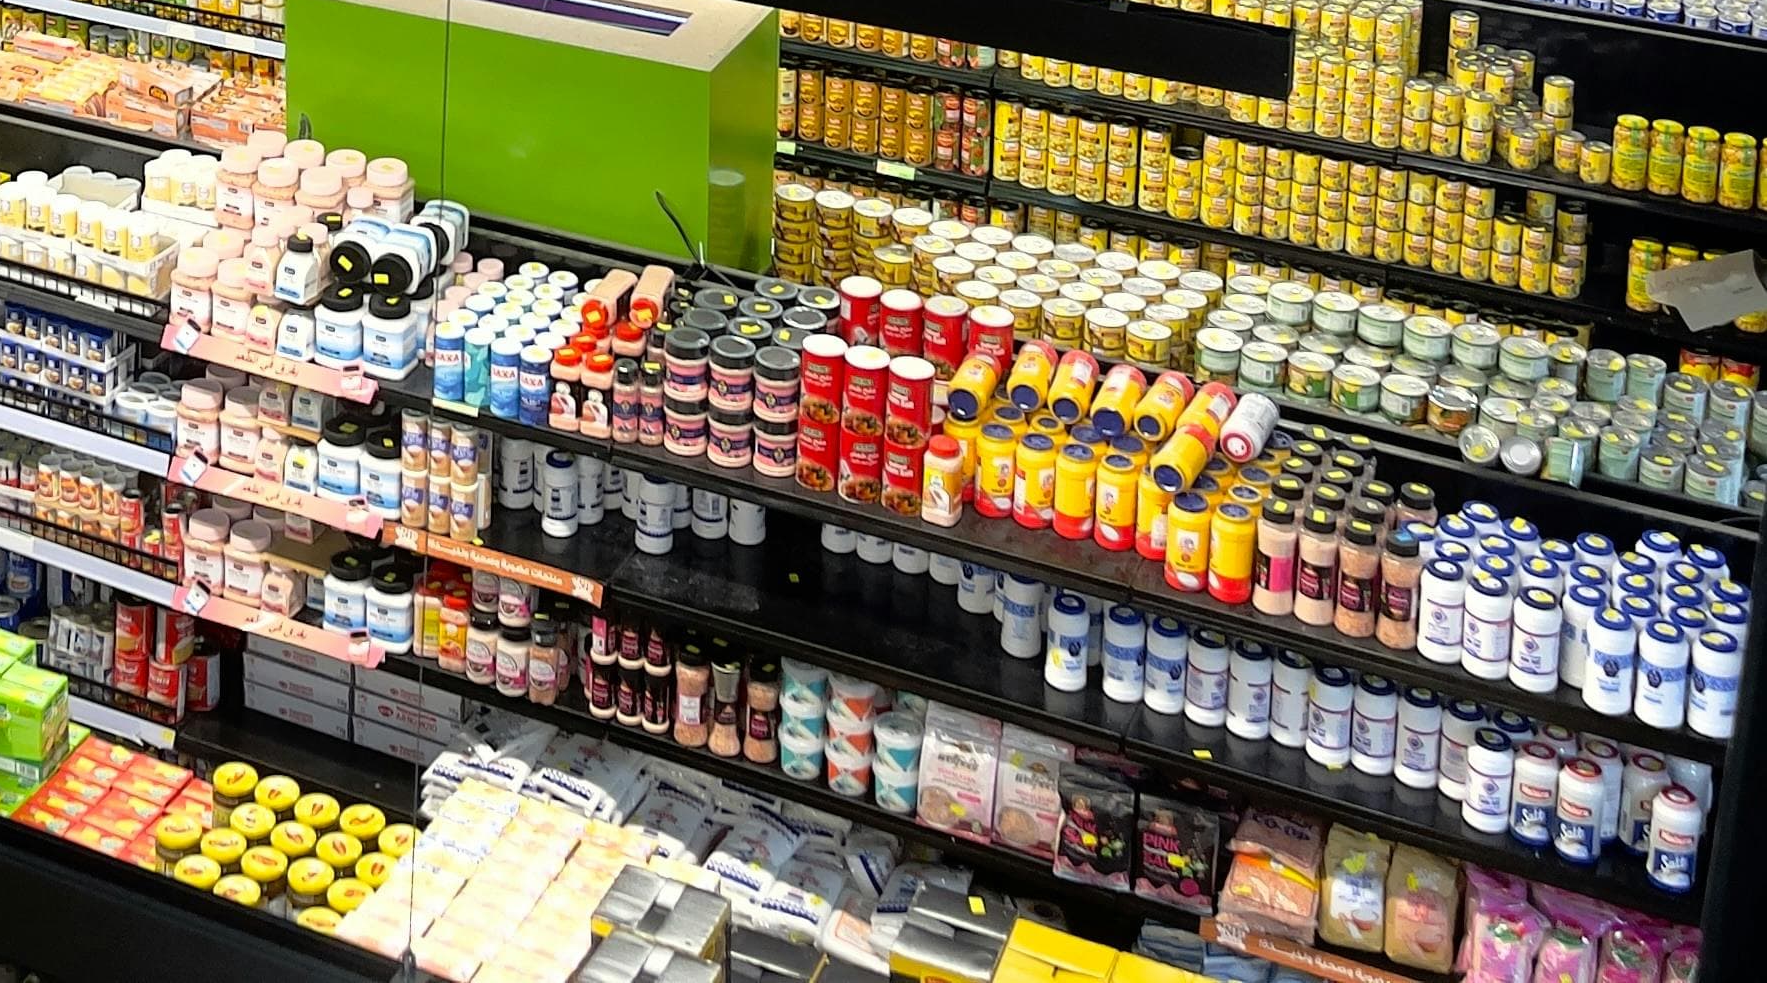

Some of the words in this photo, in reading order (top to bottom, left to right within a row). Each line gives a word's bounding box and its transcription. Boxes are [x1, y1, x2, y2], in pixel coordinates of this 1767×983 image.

[1521, 807, 1546, 824] Salt
[1143, 830, 1180, 852] PINK
[1560, 823, 1585, 841] Salt
[1660, 854, 1688, 873] Salt
